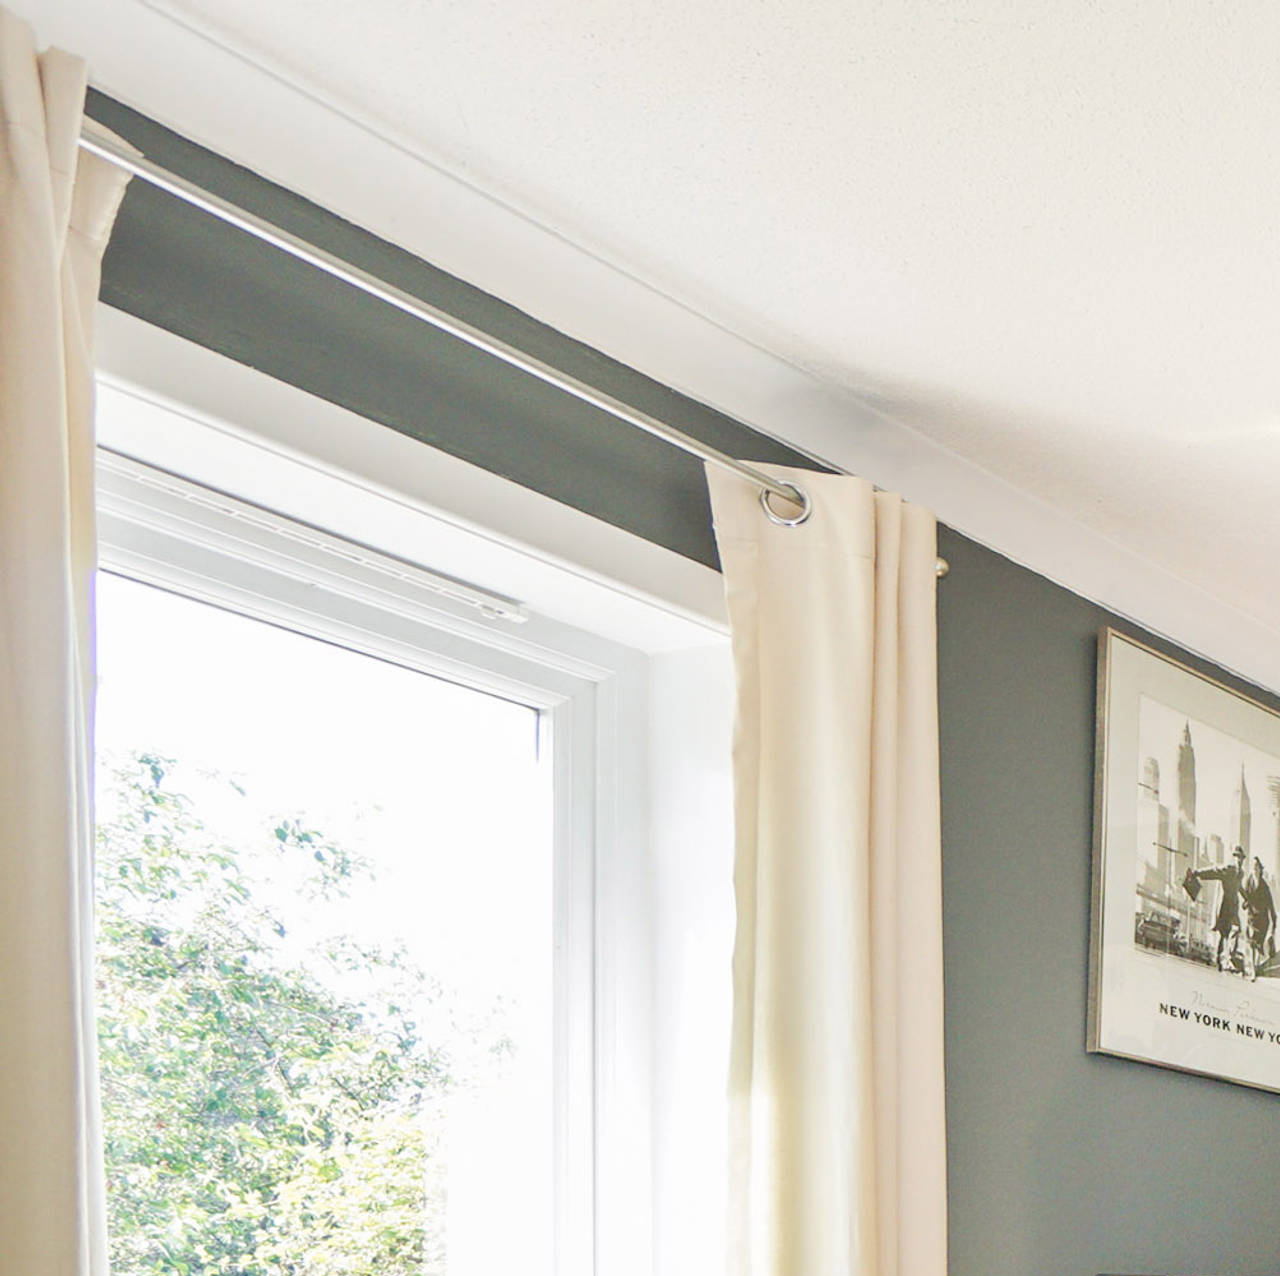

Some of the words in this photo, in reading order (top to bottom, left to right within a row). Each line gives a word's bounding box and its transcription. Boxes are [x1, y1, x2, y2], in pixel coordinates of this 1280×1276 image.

[1159, 1002, 1191, 1021] NEW
[1193, 1011, 1231, 1032] YORK
[1235, 1023, 1265, 1041] NEW
